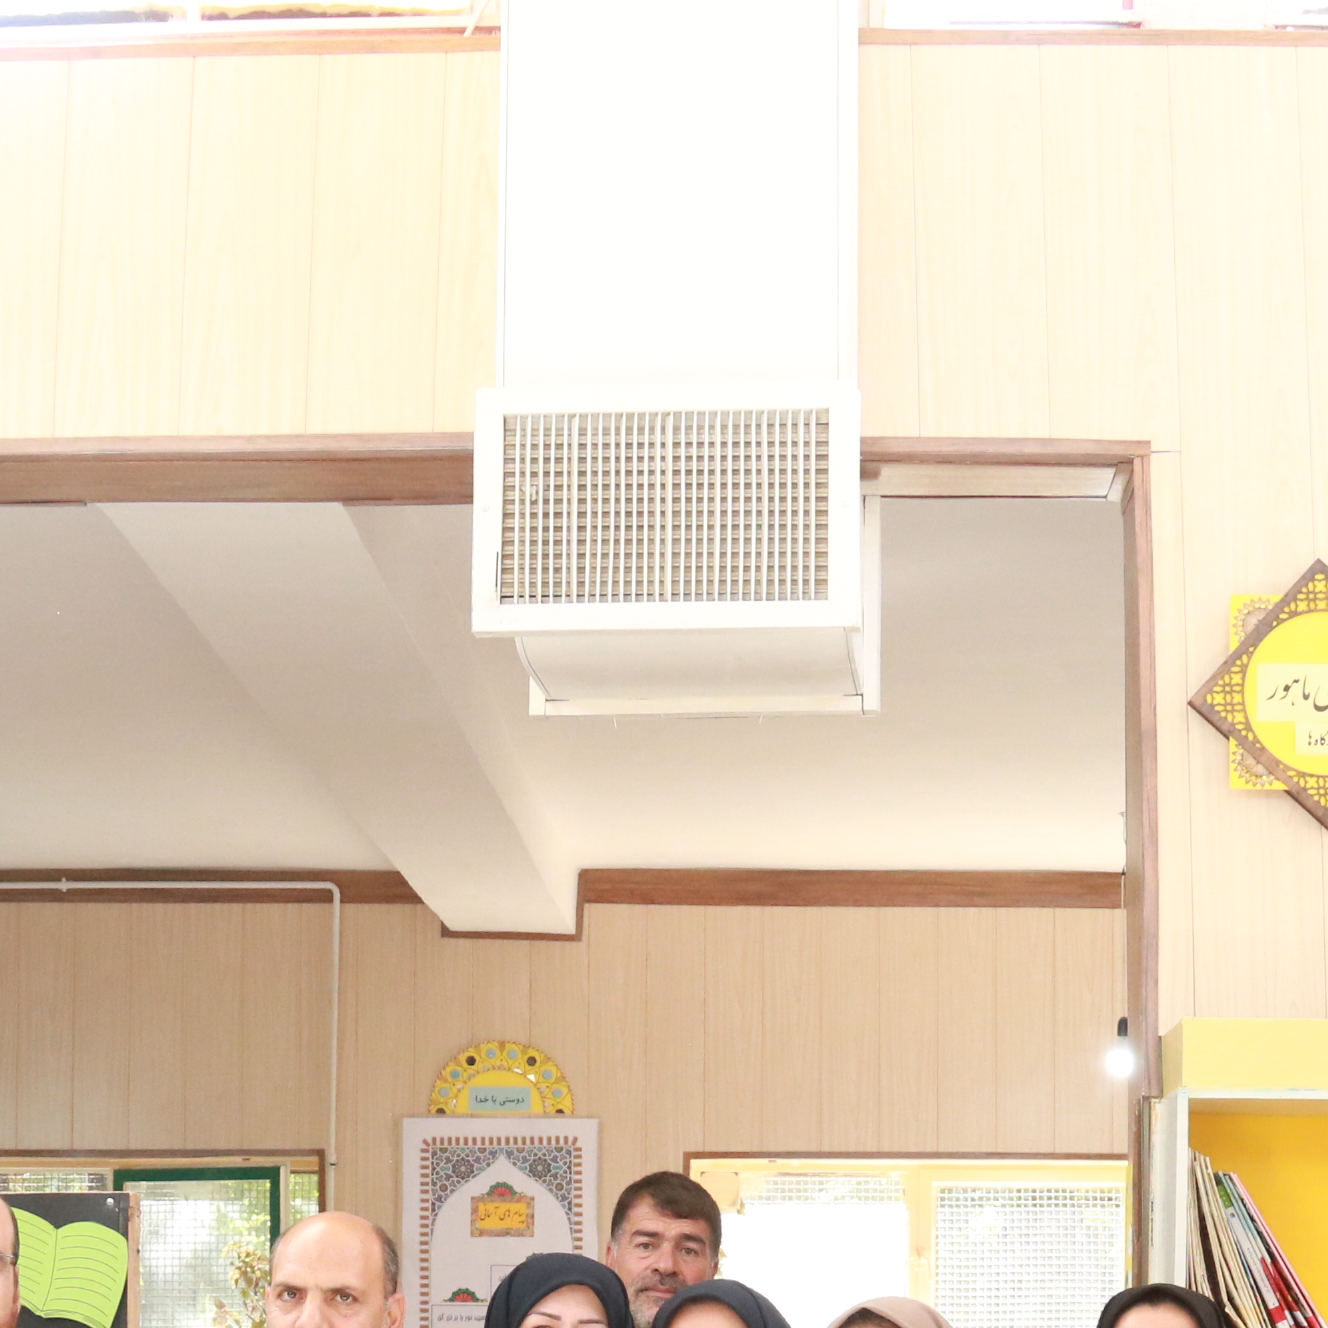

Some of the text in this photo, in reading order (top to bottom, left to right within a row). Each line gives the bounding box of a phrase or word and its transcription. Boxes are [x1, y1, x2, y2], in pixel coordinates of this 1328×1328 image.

[1265, 673, 1311, 707] ماهور
[475, 1094, 525, 1106] دوستی با خدا
